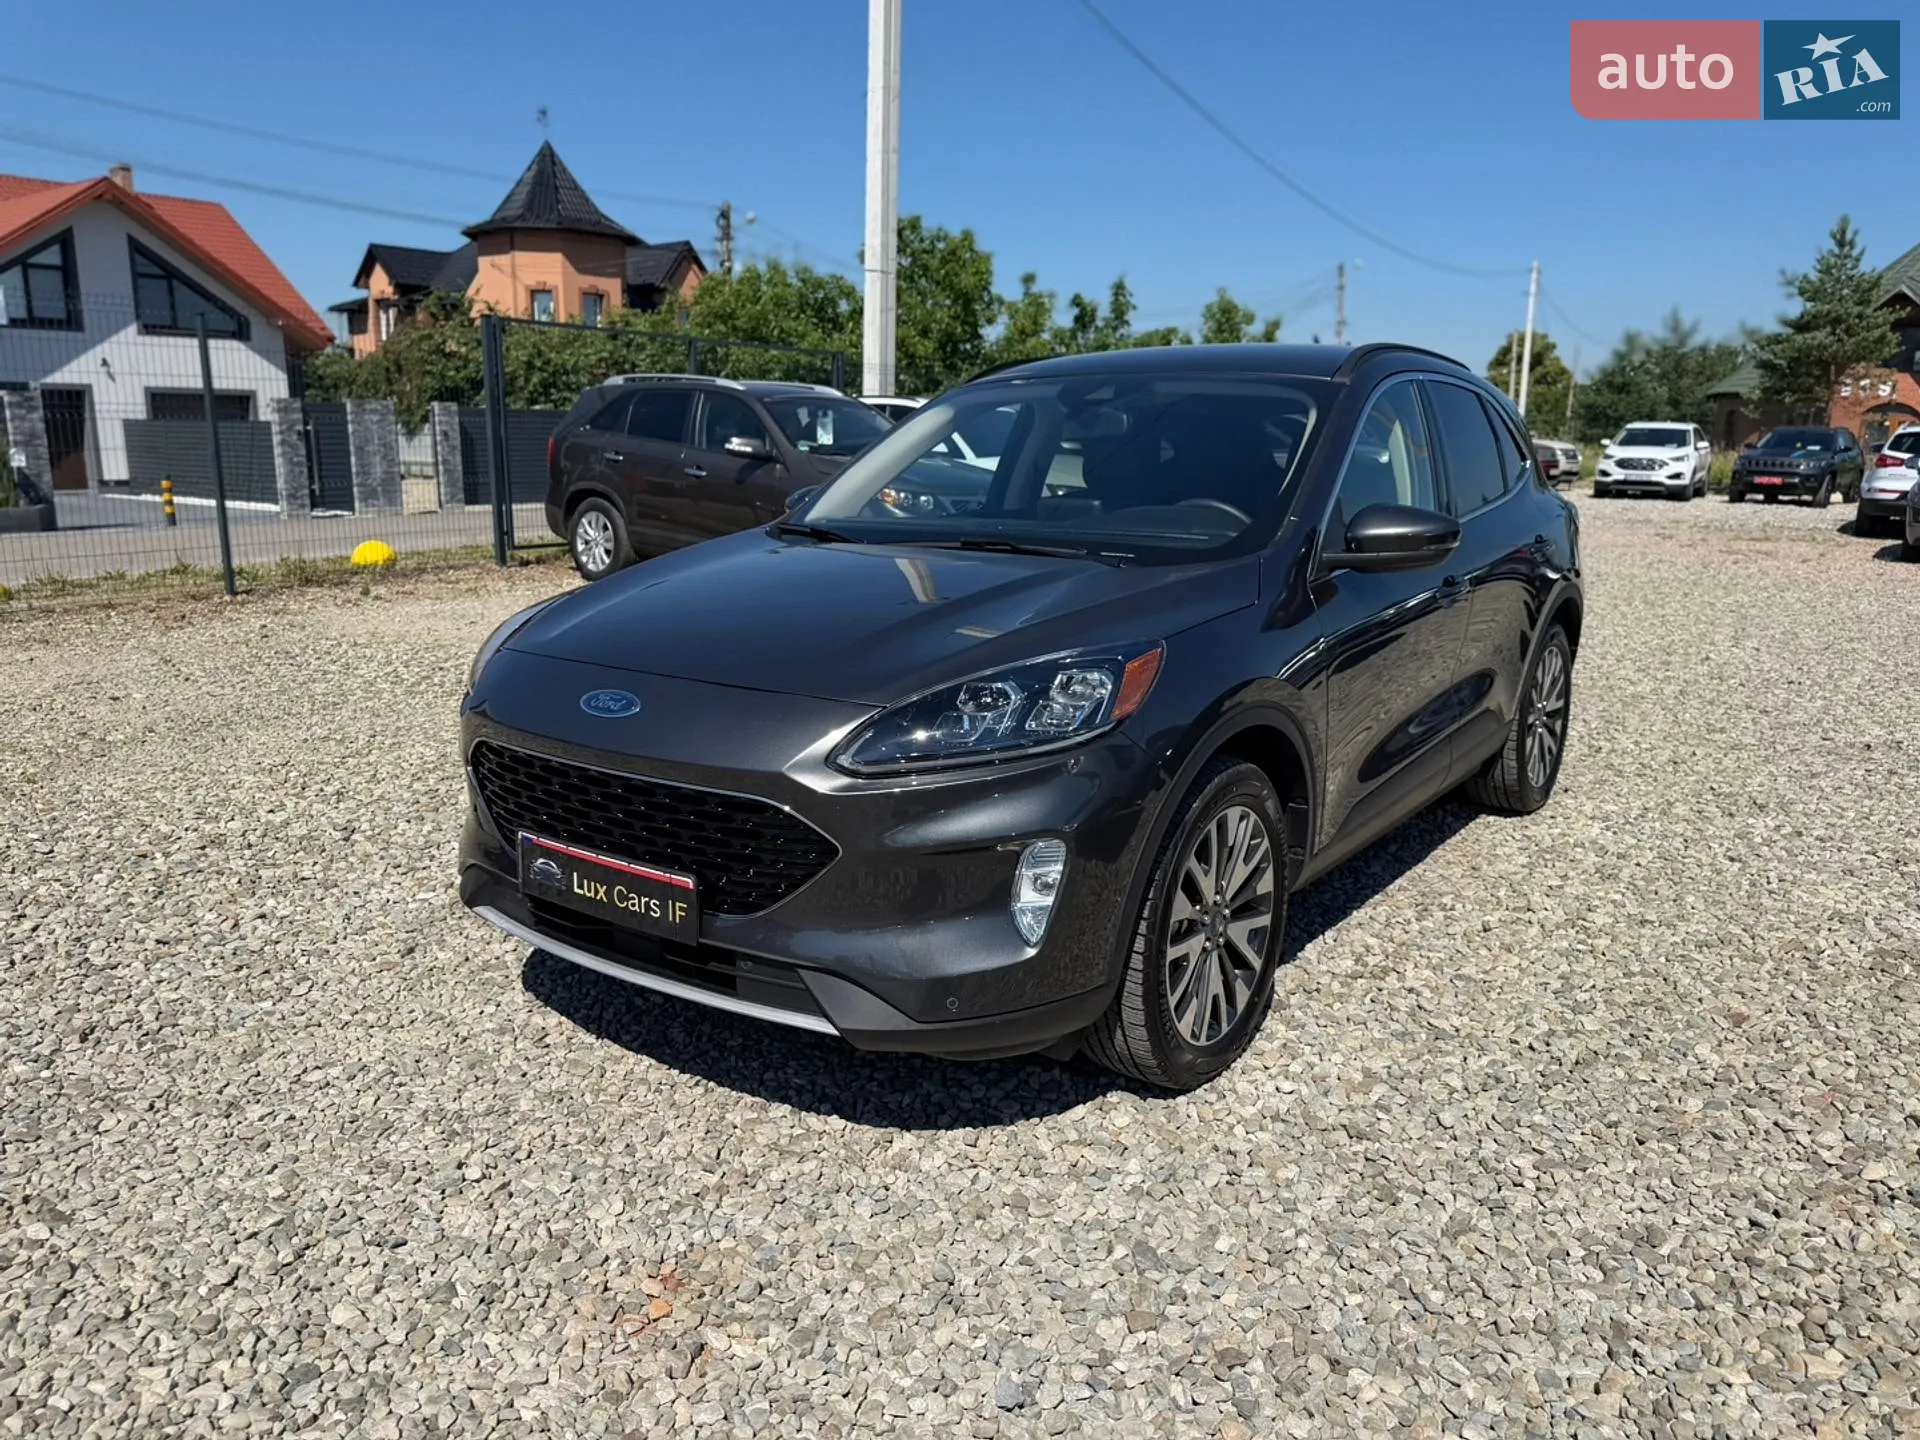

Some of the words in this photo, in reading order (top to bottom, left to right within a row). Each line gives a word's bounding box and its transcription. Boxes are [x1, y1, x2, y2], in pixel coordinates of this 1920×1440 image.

[590, 694, 627, 710] Ford
[573, 871, 609, 903] Lux
[613, 885, 662, 918] Cars
[668, 899, 688, 924] IF
